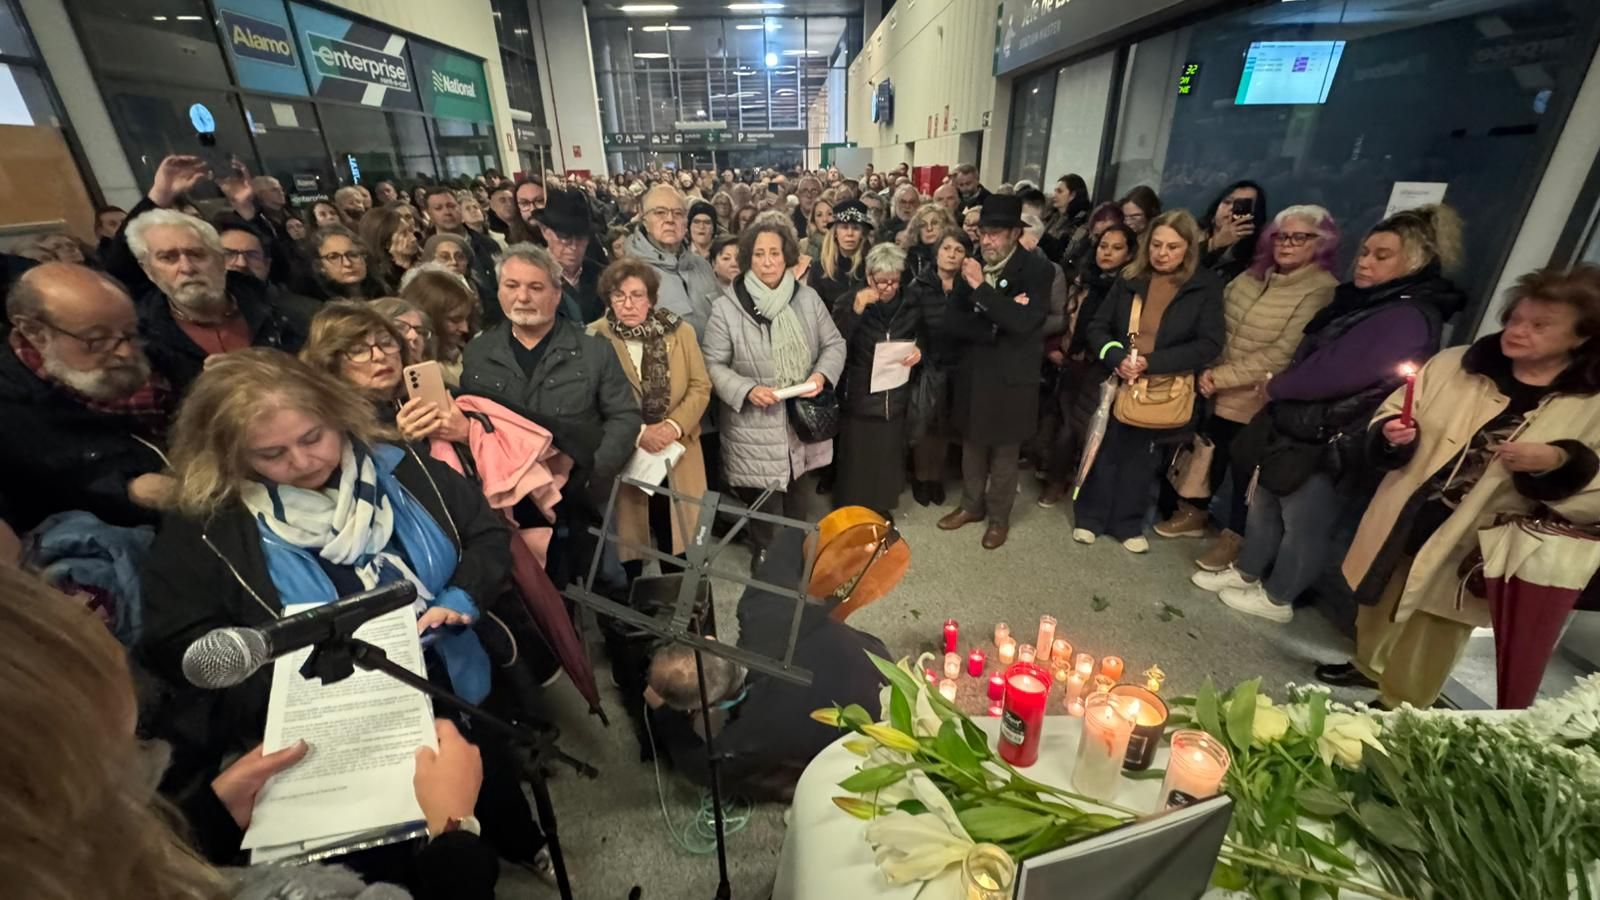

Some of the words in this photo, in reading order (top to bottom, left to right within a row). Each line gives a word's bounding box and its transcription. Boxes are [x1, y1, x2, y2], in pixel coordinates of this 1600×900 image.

[232, 24, 291, 56] Alamo
[316, 45, 407, 81] enterprise
[442, 77, 477, 98] National
